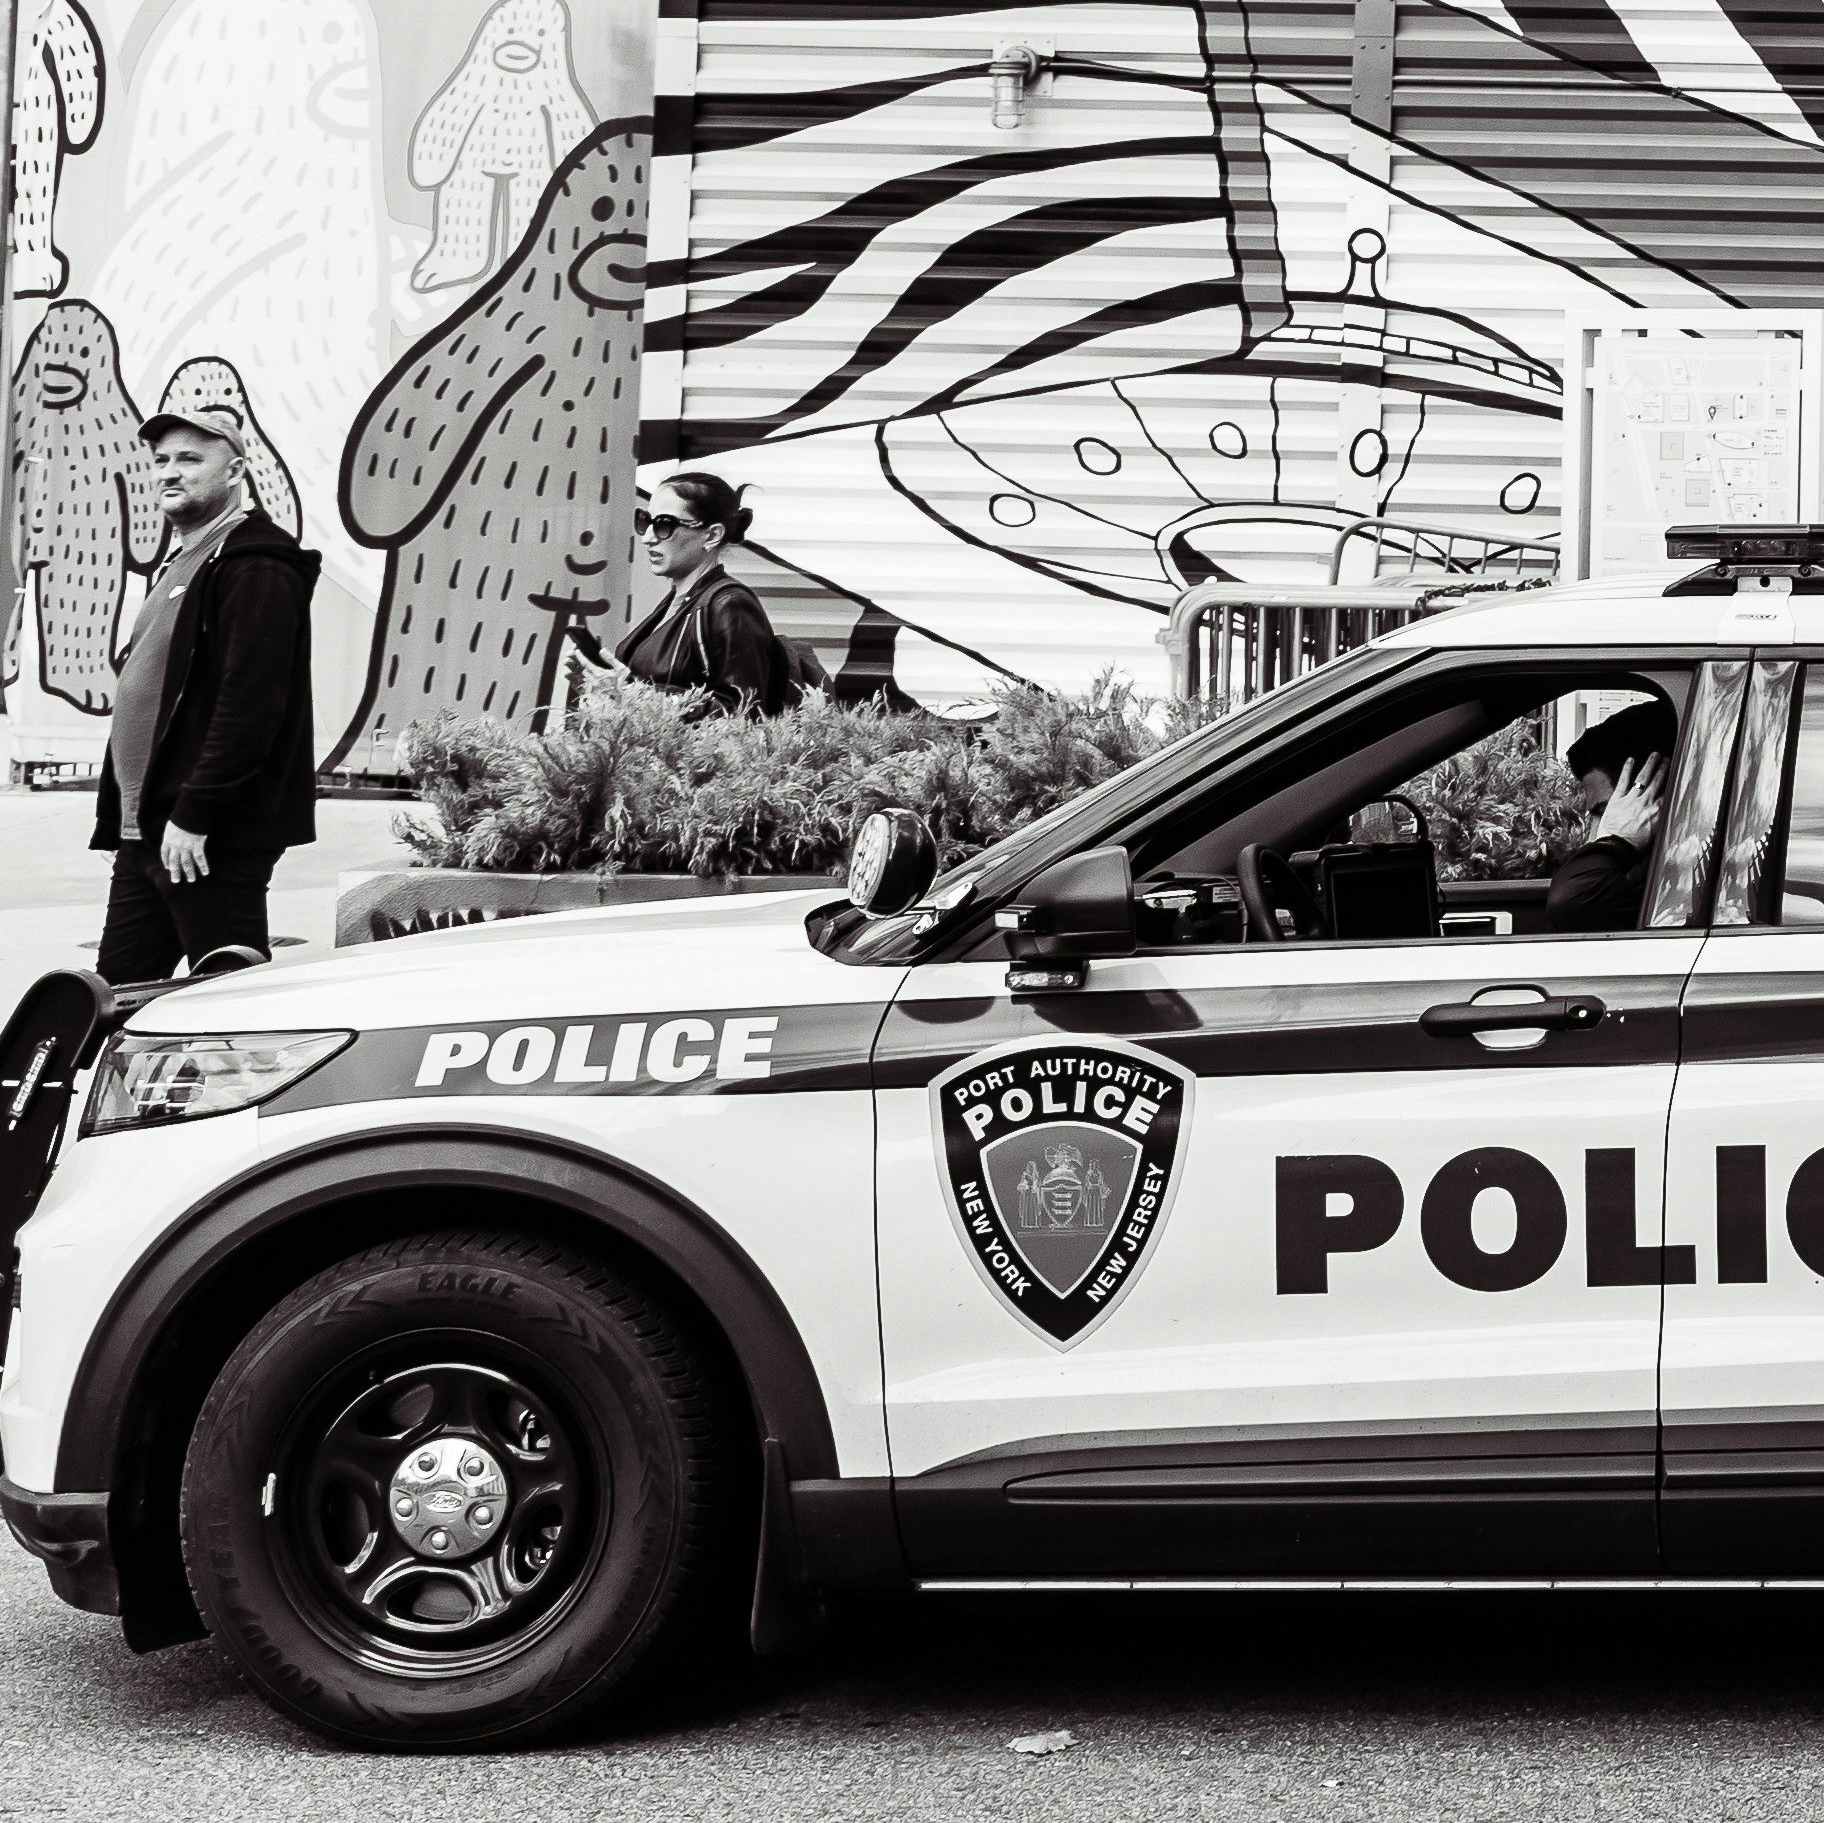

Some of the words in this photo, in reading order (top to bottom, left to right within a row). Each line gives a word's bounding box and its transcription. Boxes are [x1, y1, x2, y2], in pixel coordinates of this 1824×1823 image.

[413, 1015, 779, 1088] POLICE
[953, 1065, 1015, 1107] PORT
[1029, 1057, 1172, 1101] AUTHORITY
[961, 1080, 1161, 1143] POLICE
[961, 1180, 993, 1236] NEW
[983, 1237, 1032, 1298] YORK
[1086, 1254, 1128, 1303] NEW
[1127, 1161, 1165, 1253] JERSEY
[417, 1272, 523, 1303] EAGLE
